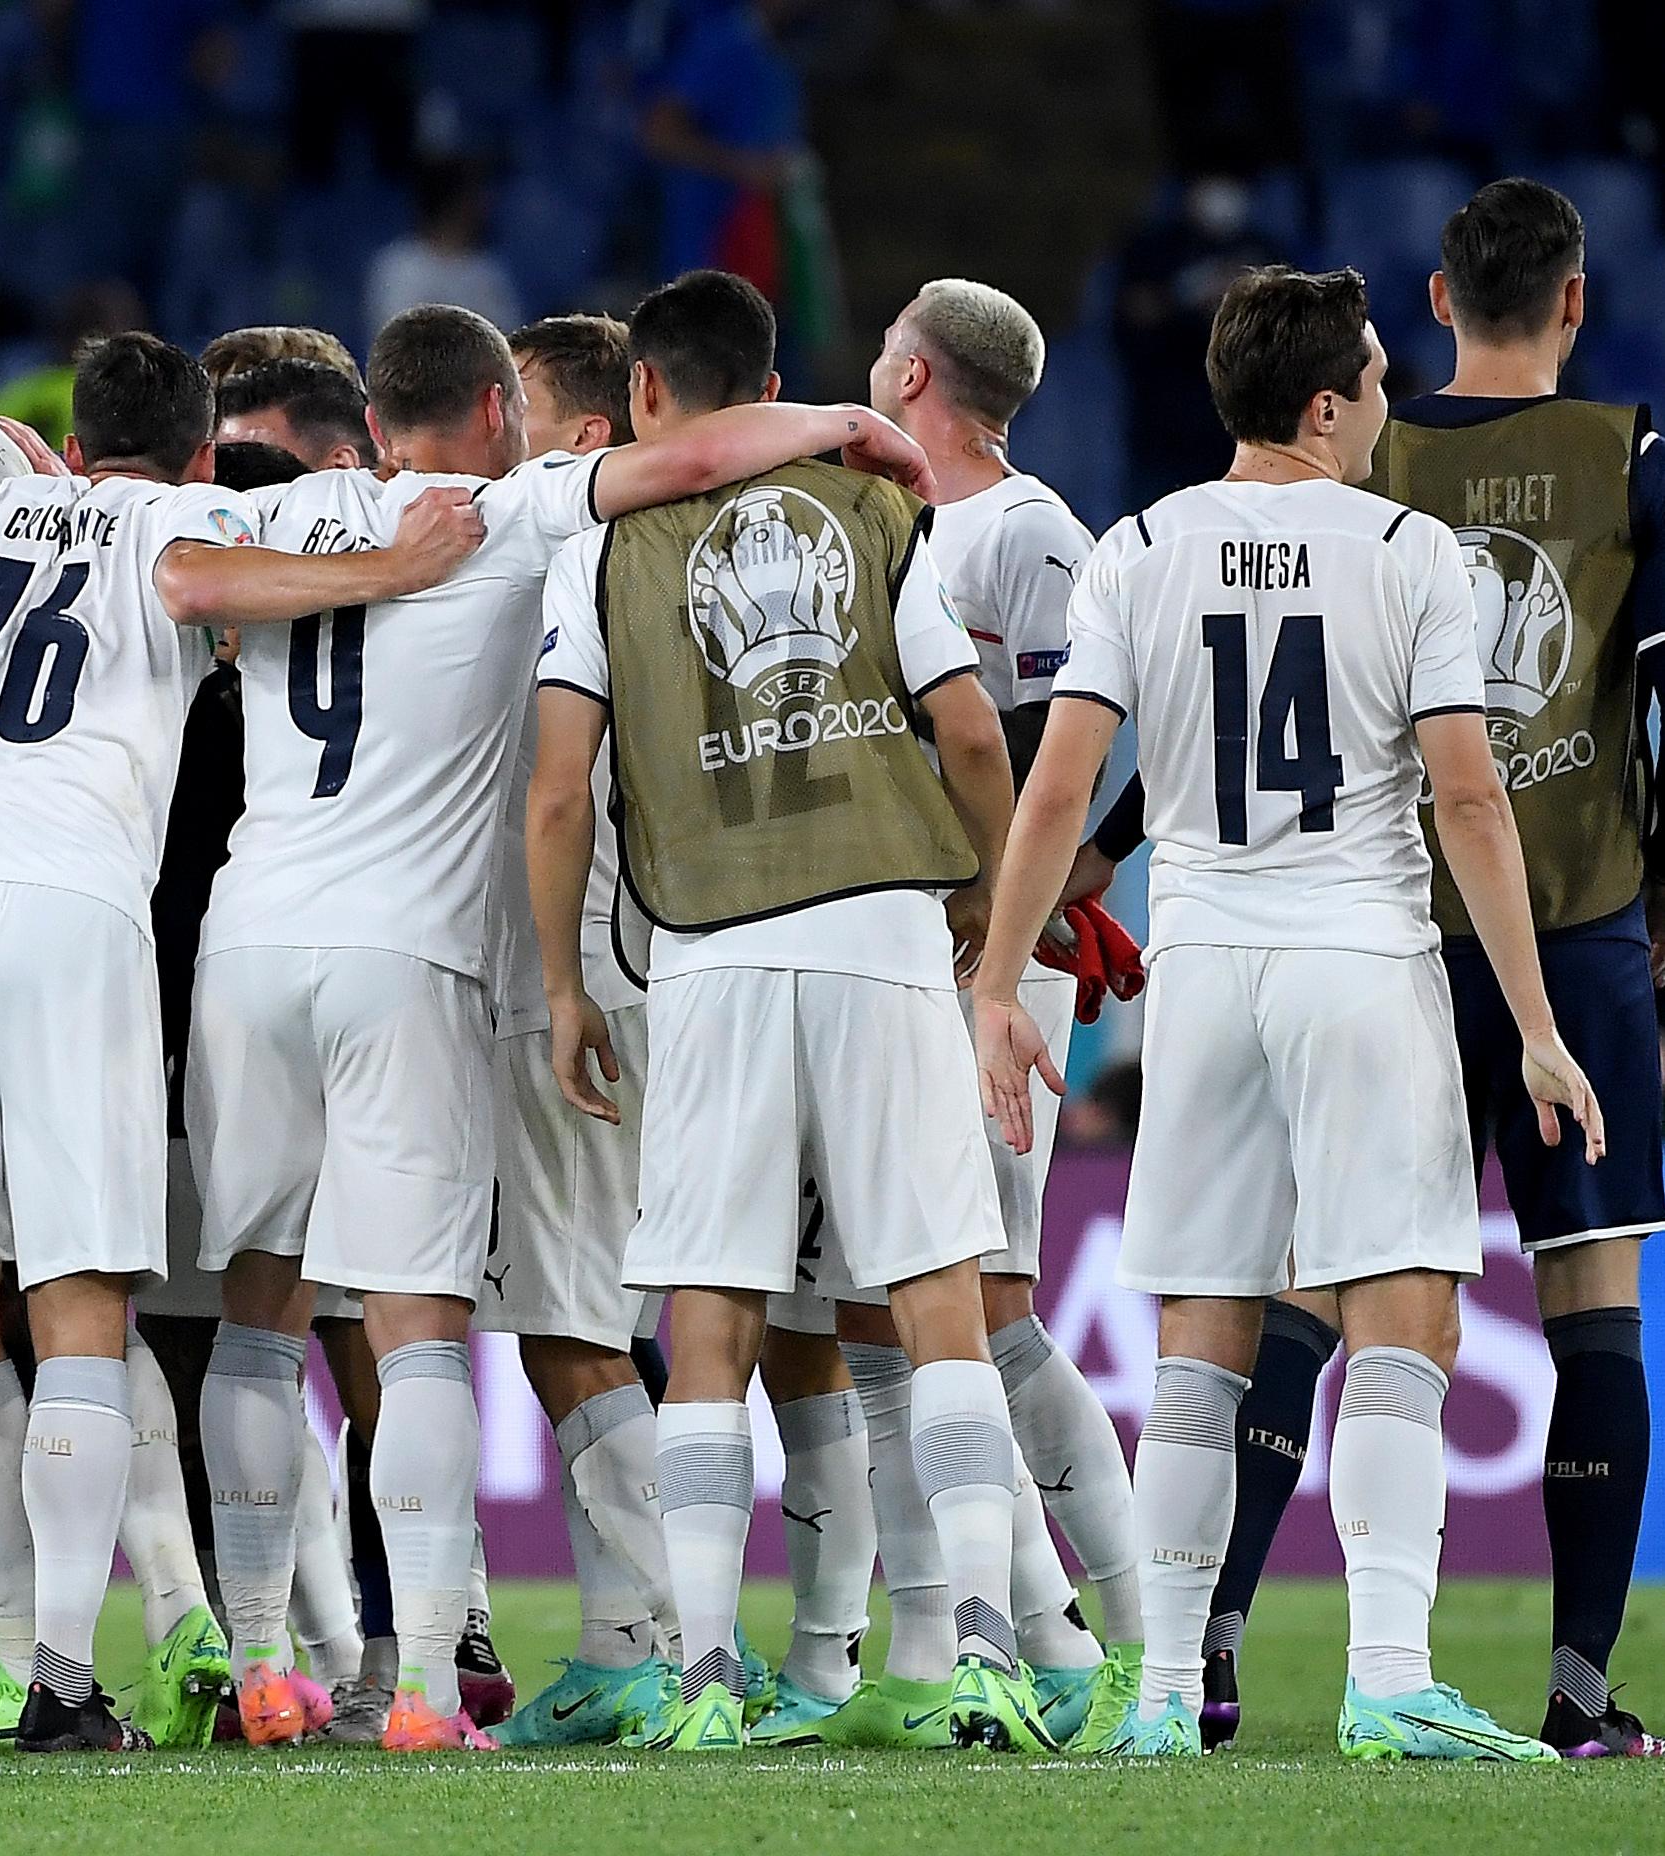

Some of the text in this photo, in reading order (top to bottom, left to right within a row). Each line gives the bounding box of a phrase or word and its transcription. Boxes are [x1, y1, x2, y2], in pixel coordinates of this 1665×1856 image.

[1465, 474, 1557, 525] MERET
[3, 503, 120, 562] CRISANTE
[1220, 541, 1312, 591] CHIESA
[757, 674, 826, 708] UEFA
[697, 696, 910, 772] EURO2020
[1201, 613, 1344, 847] 14
[1489, 722, 1520, 747] FA
[1546, 1460, 1609, 1478] TALIA
[1152, 1548, 1217, 1570] ITALIA
